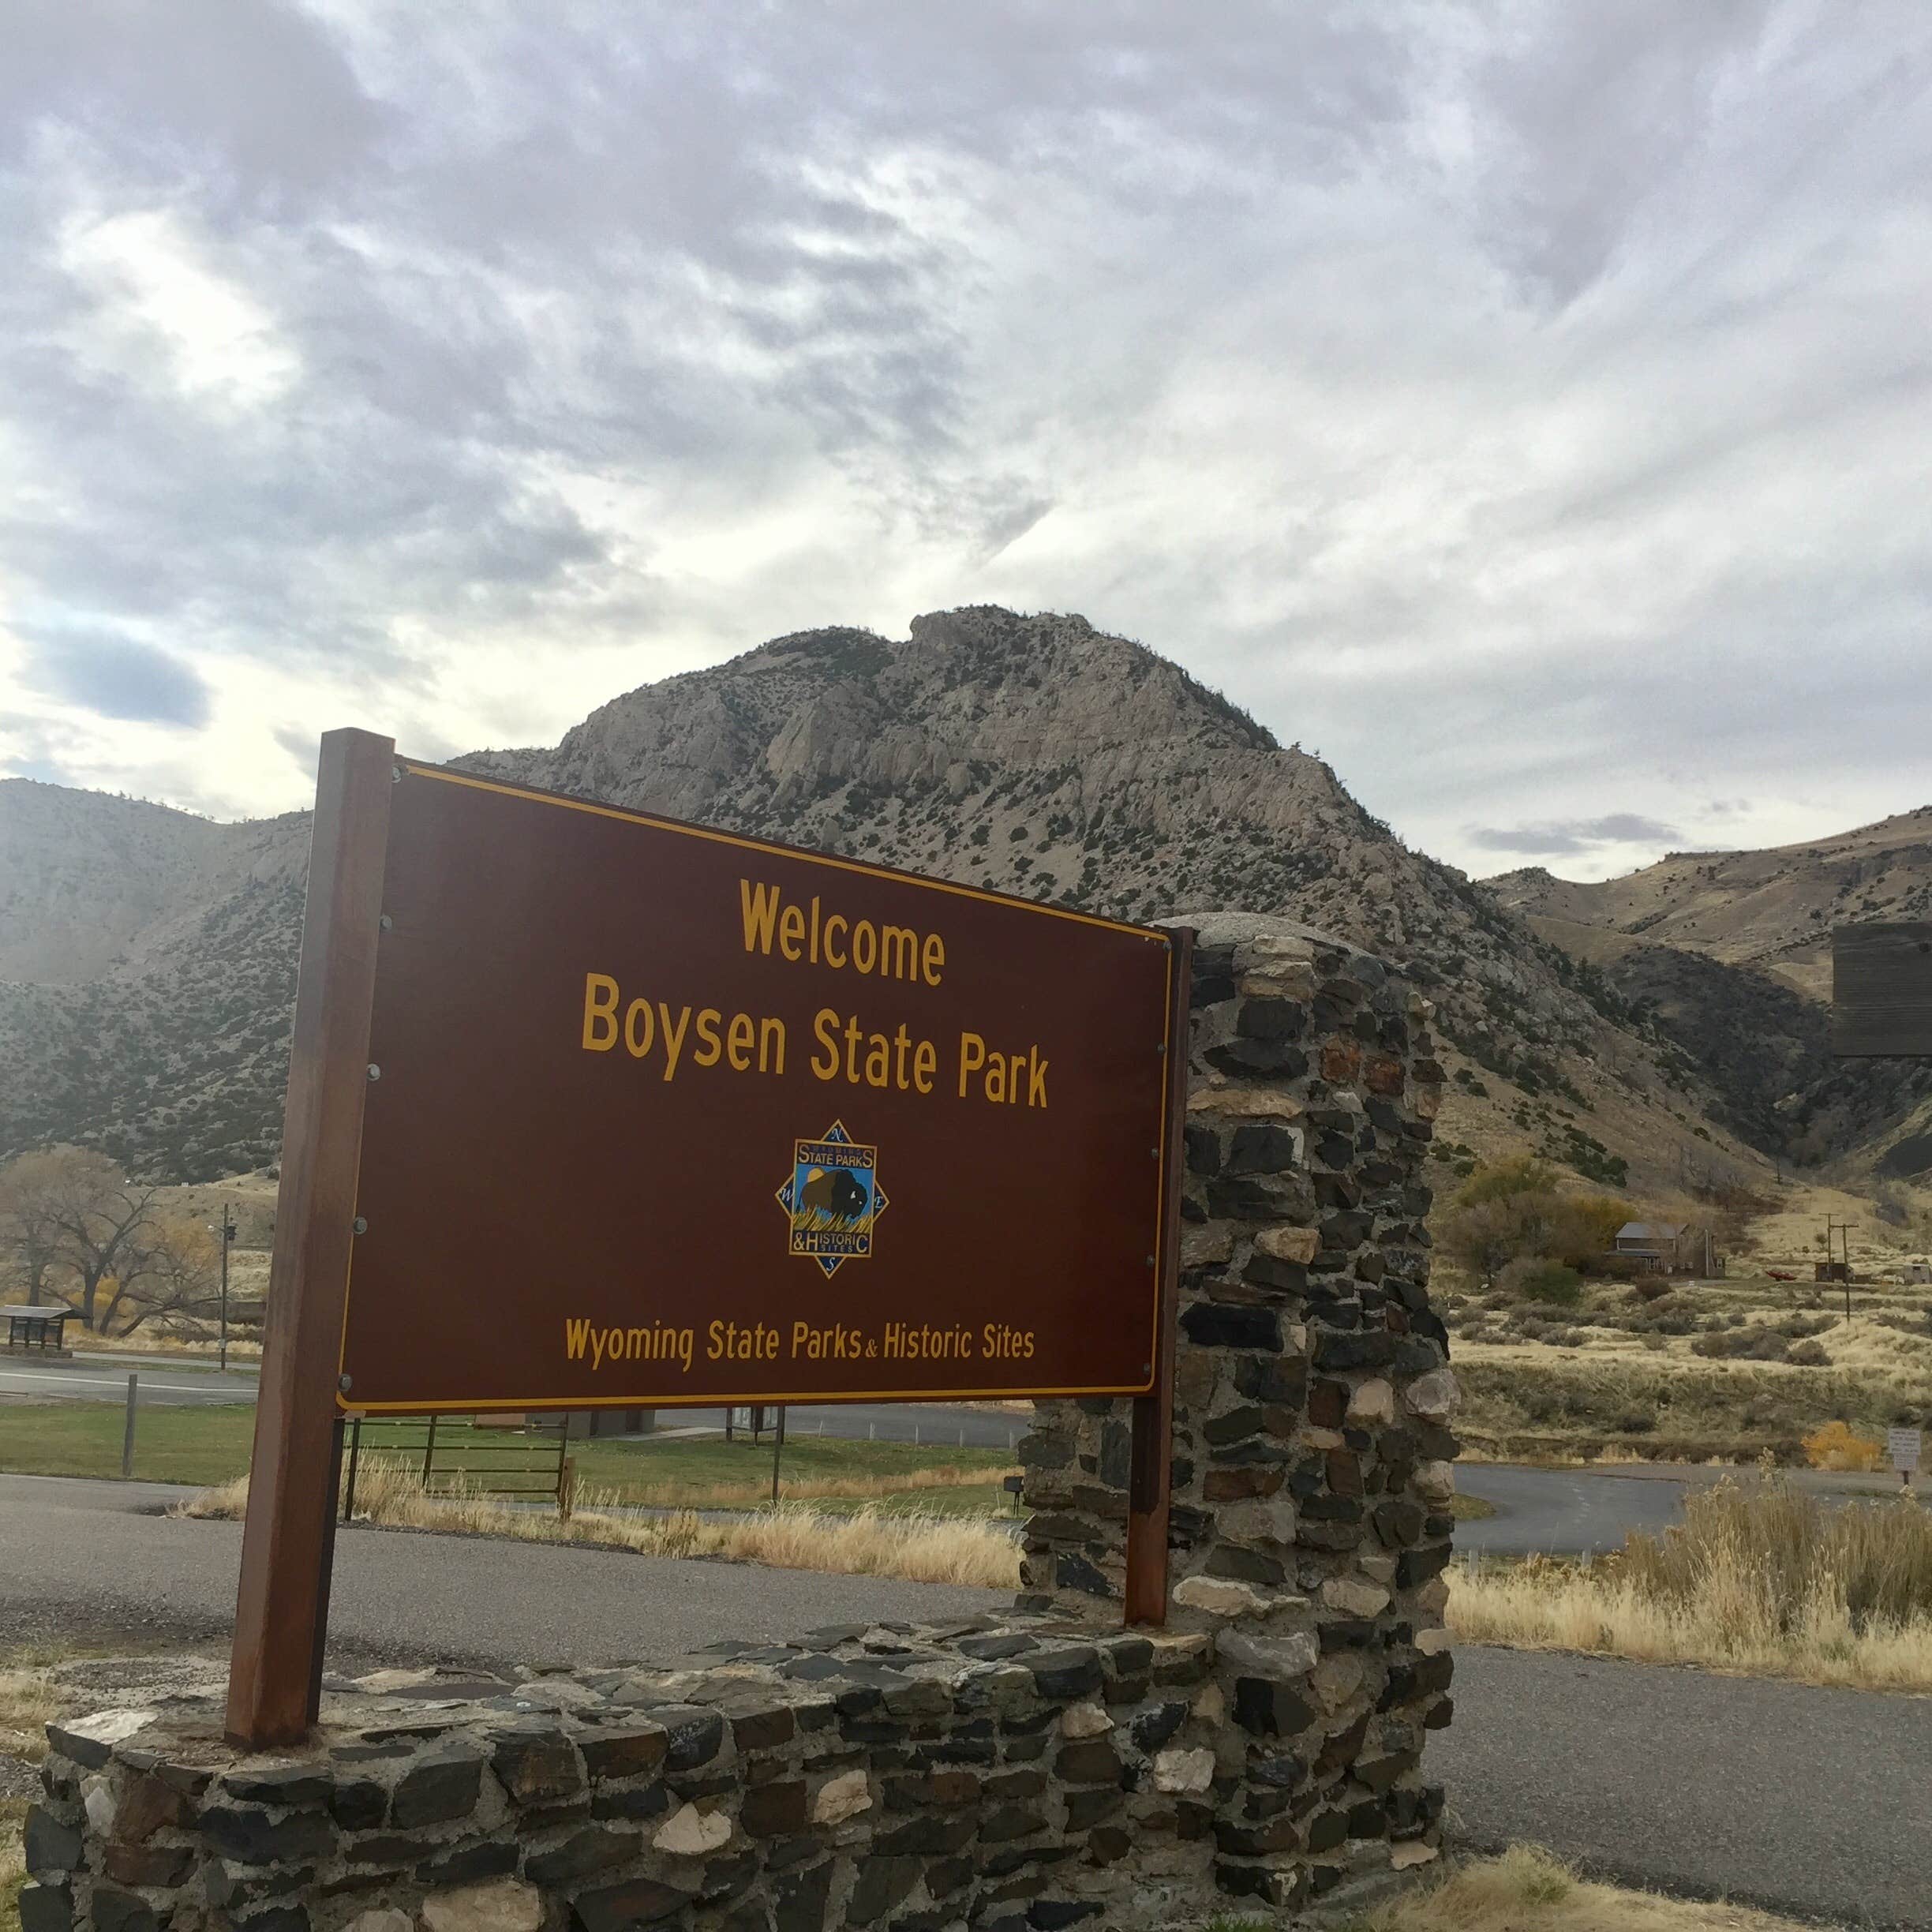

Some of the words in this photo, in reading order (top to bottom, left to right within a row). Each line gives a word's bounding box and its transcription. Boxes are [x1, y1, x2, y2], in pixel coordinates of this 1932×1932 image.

[740, 878, 945, 987] Welcome
[582, 972, 786, 1082] Boysen
[811, 1008, 937, 1095] State
[958, 1032, 1049, 1109] Park
[832, 1128, 844, 1142] N
[799, 1145, 833, 1166] STATE
[836, 1150, 873, 1169] PARKS
[821, 1244, 853, 1253] SITES
[826, 1256, 835, 1271] S
[565, 1318, 695, 1372] Wyoming
[706, 1320, 781, 1360] State
[791, 1321, 863, 1359] Parks
[864, 1339, 878, 1358] &
[883, 1323, 973, 1359] Historic
[982, 1323, 1035, 1359] Sites
